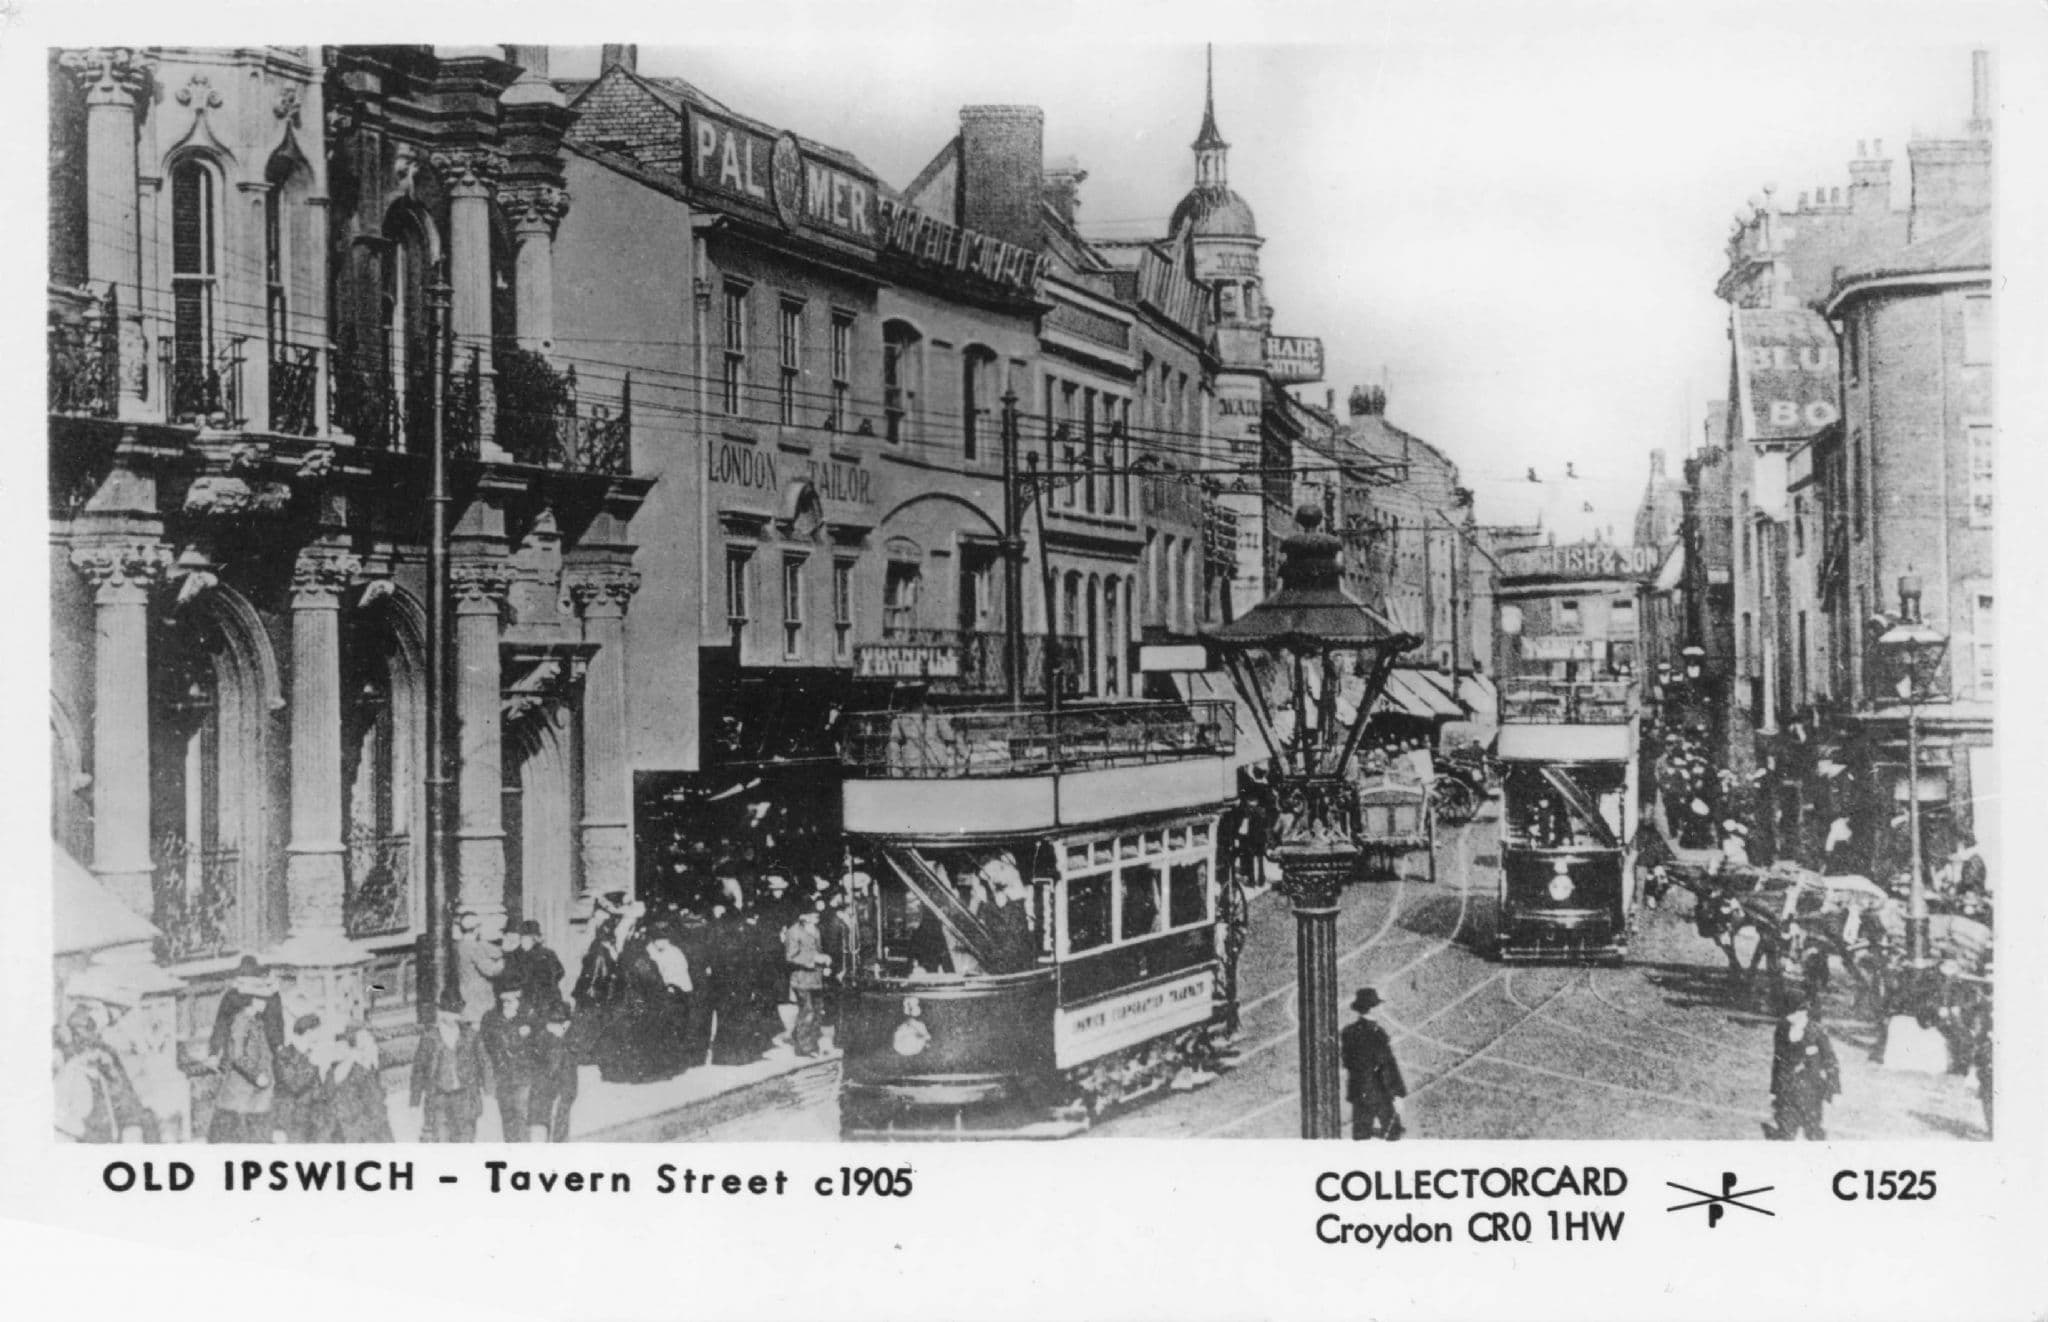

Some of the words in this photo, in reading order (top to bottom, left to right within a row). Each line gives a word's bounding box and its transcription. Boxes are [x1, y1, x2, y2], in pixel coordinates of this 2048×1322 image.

[698, 120, 765, 198] PAL
[1267, 338, 1319, 358] HAIR
[708, 440, 777, 491] LONDON
[1601, 548, 1616, 576] &
[1619, 547, 1659, 574] SON
